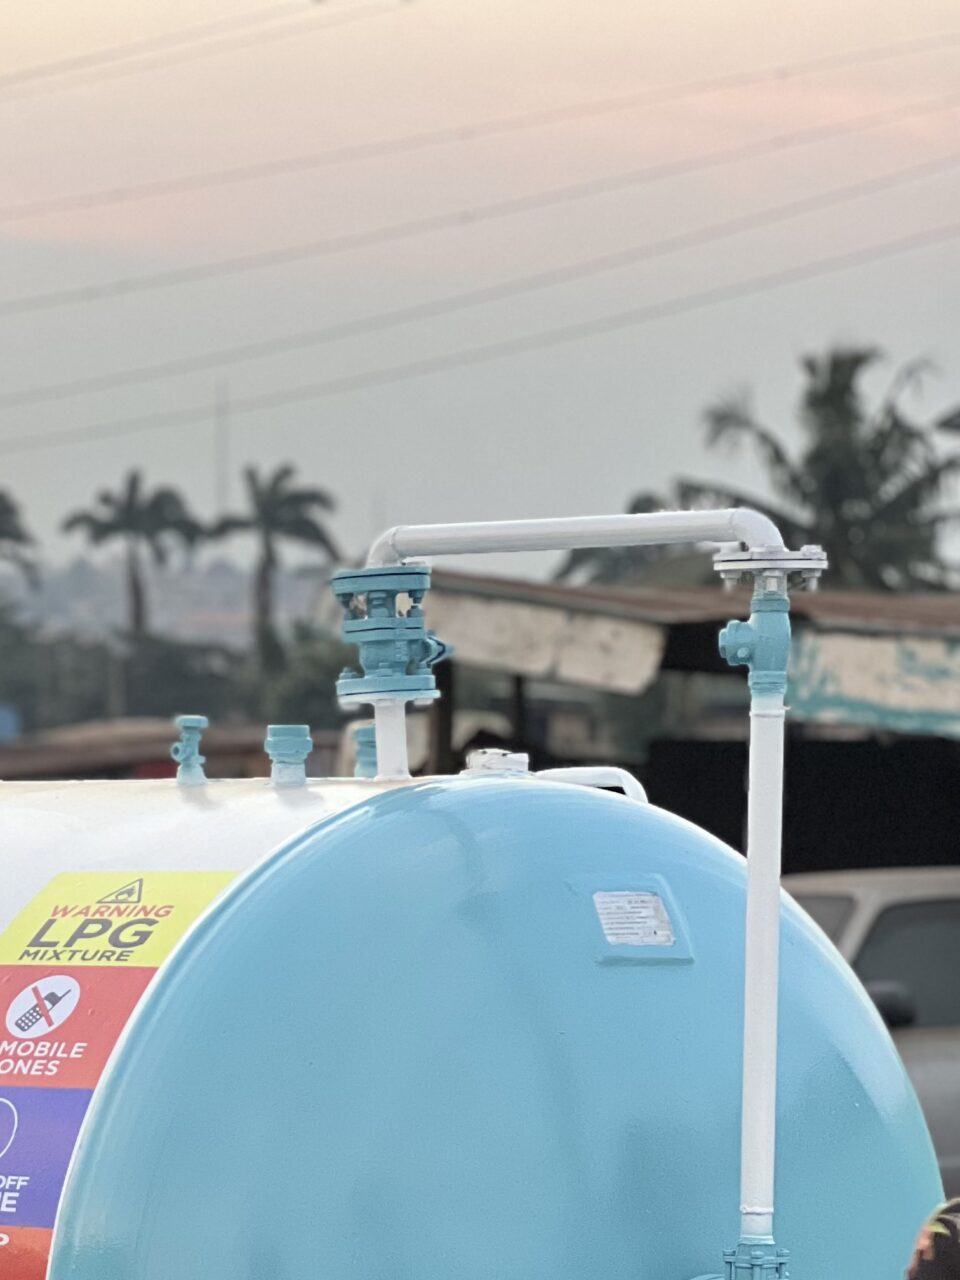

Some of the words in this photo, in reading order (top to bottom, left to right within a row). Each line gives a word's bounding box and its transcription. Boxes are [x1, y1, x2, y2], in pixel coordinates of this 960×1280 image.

[50, 904, 176, 918] WARNING
[26, 917, 160, 949] LPG
[17, 949, 135, 962] MIXTURE
